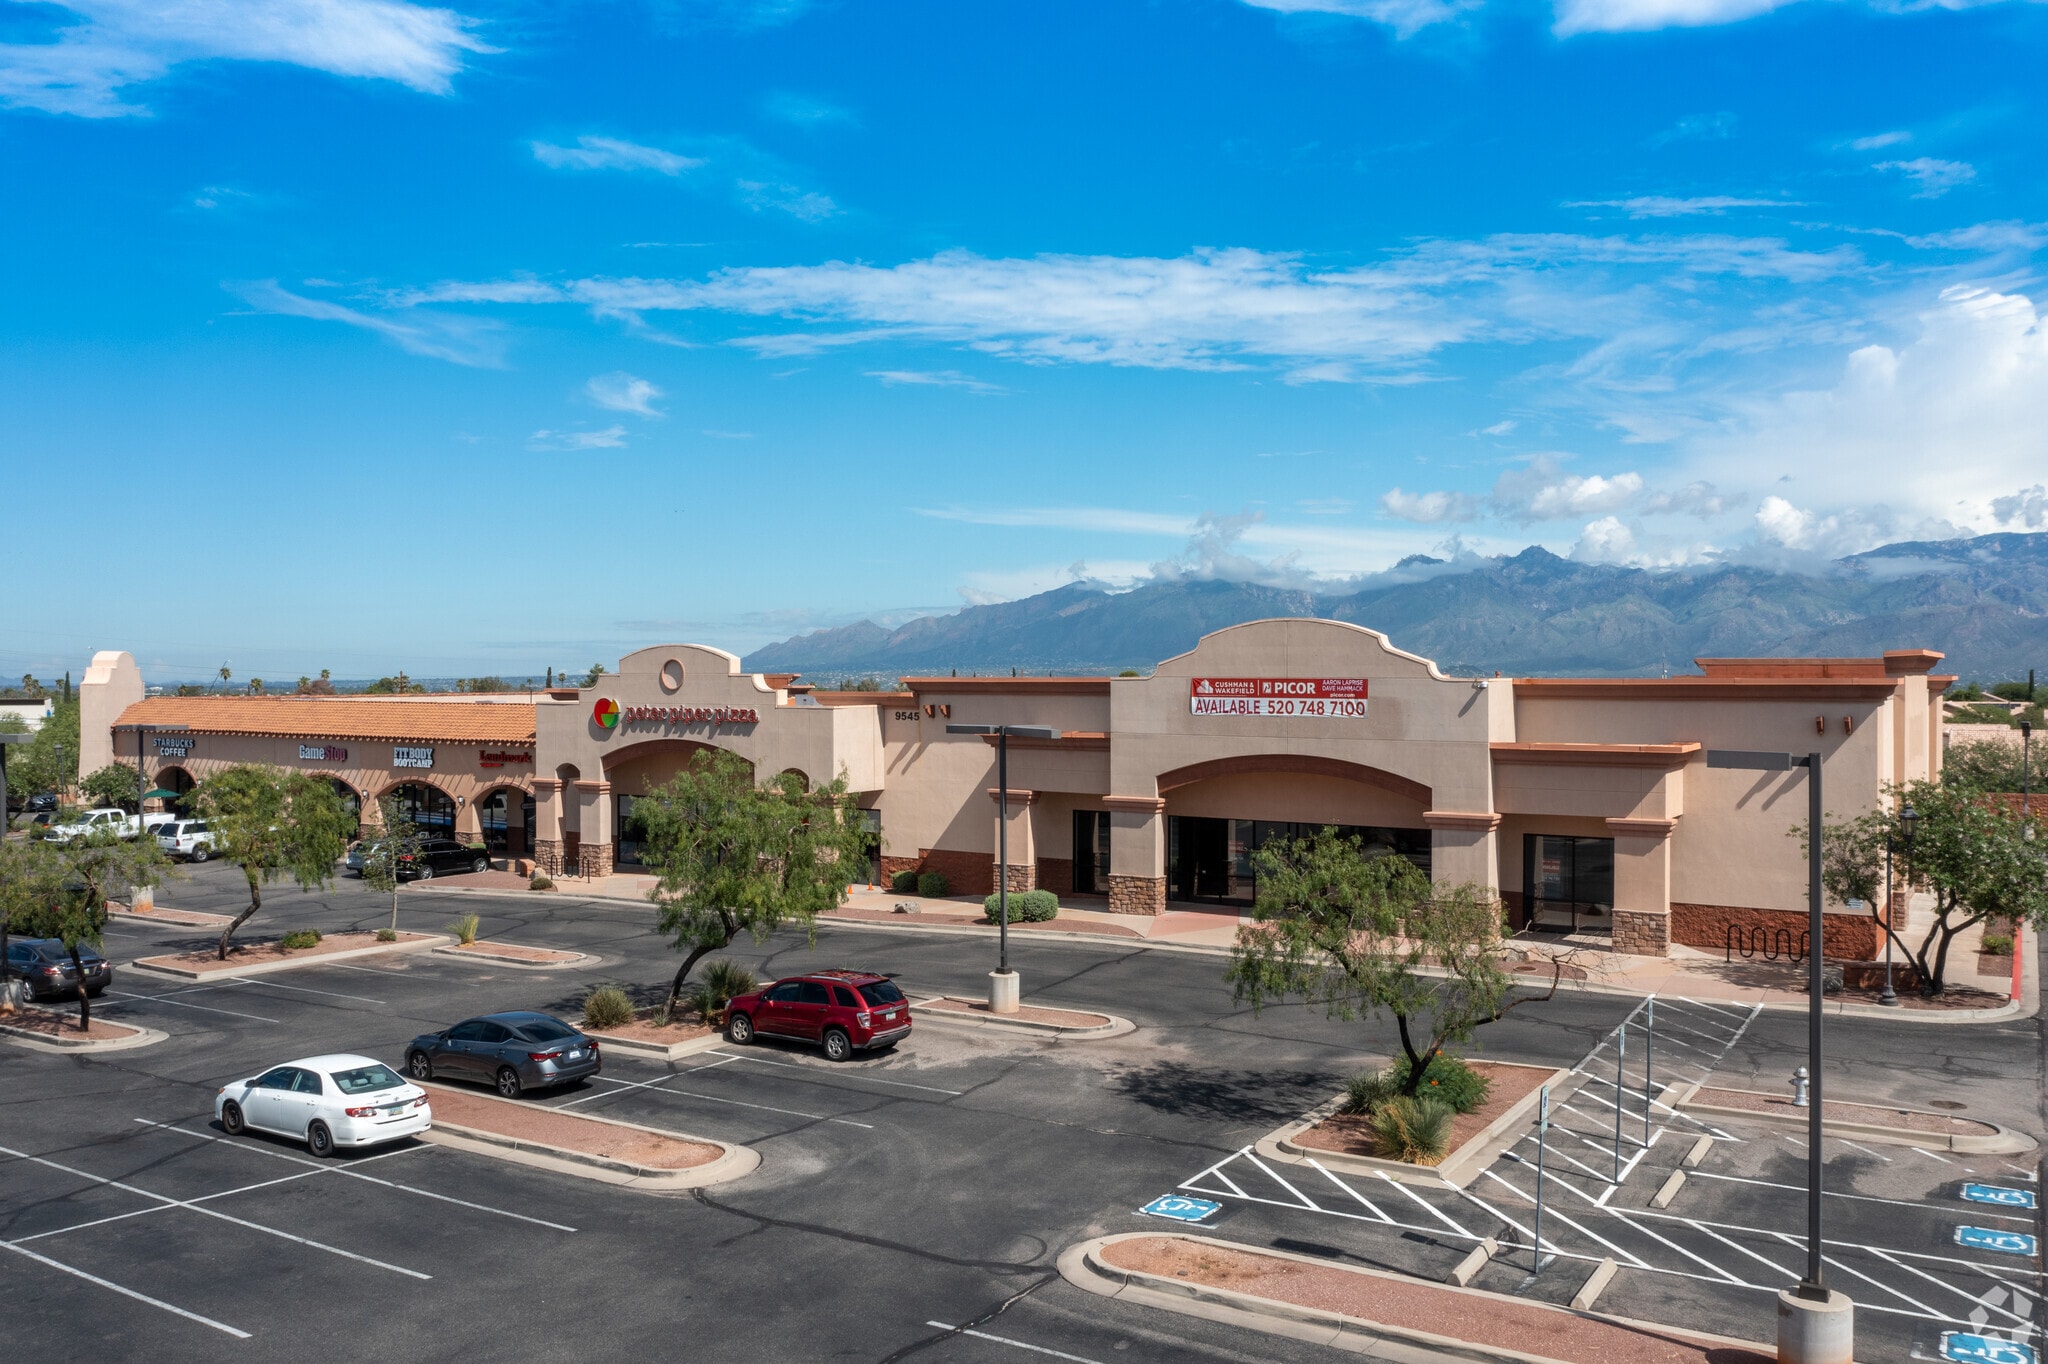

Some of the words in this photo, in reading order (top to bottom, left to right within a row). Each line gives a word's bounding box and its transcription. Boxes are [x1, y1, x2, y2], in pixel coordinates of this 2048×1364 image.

[1274, 682, 1316, 694] PICOR
[1196, 700, 1260, 714] AVAILABLE
[1268, 700, 1294, 714] 520
[1299, 701, 1324, 715] 748
[1330, 701, 1365, 716] 7100
[626, 704, 669, 724] peter
[669, 704, 713, 725] piper
[714, 704, 759, 725] pizza
[895, 712, 920, 720] 9545
[153, 738, 194, 748] STARBUCKS
[160, 748, 186, 756] COFFEE
[299, 744, 346, 762] GameStop
[394, 747, 408, 758] FIT
[409, 748, 433, 759] BODY
[394, 758, 433, 768] BOOTCAMP
